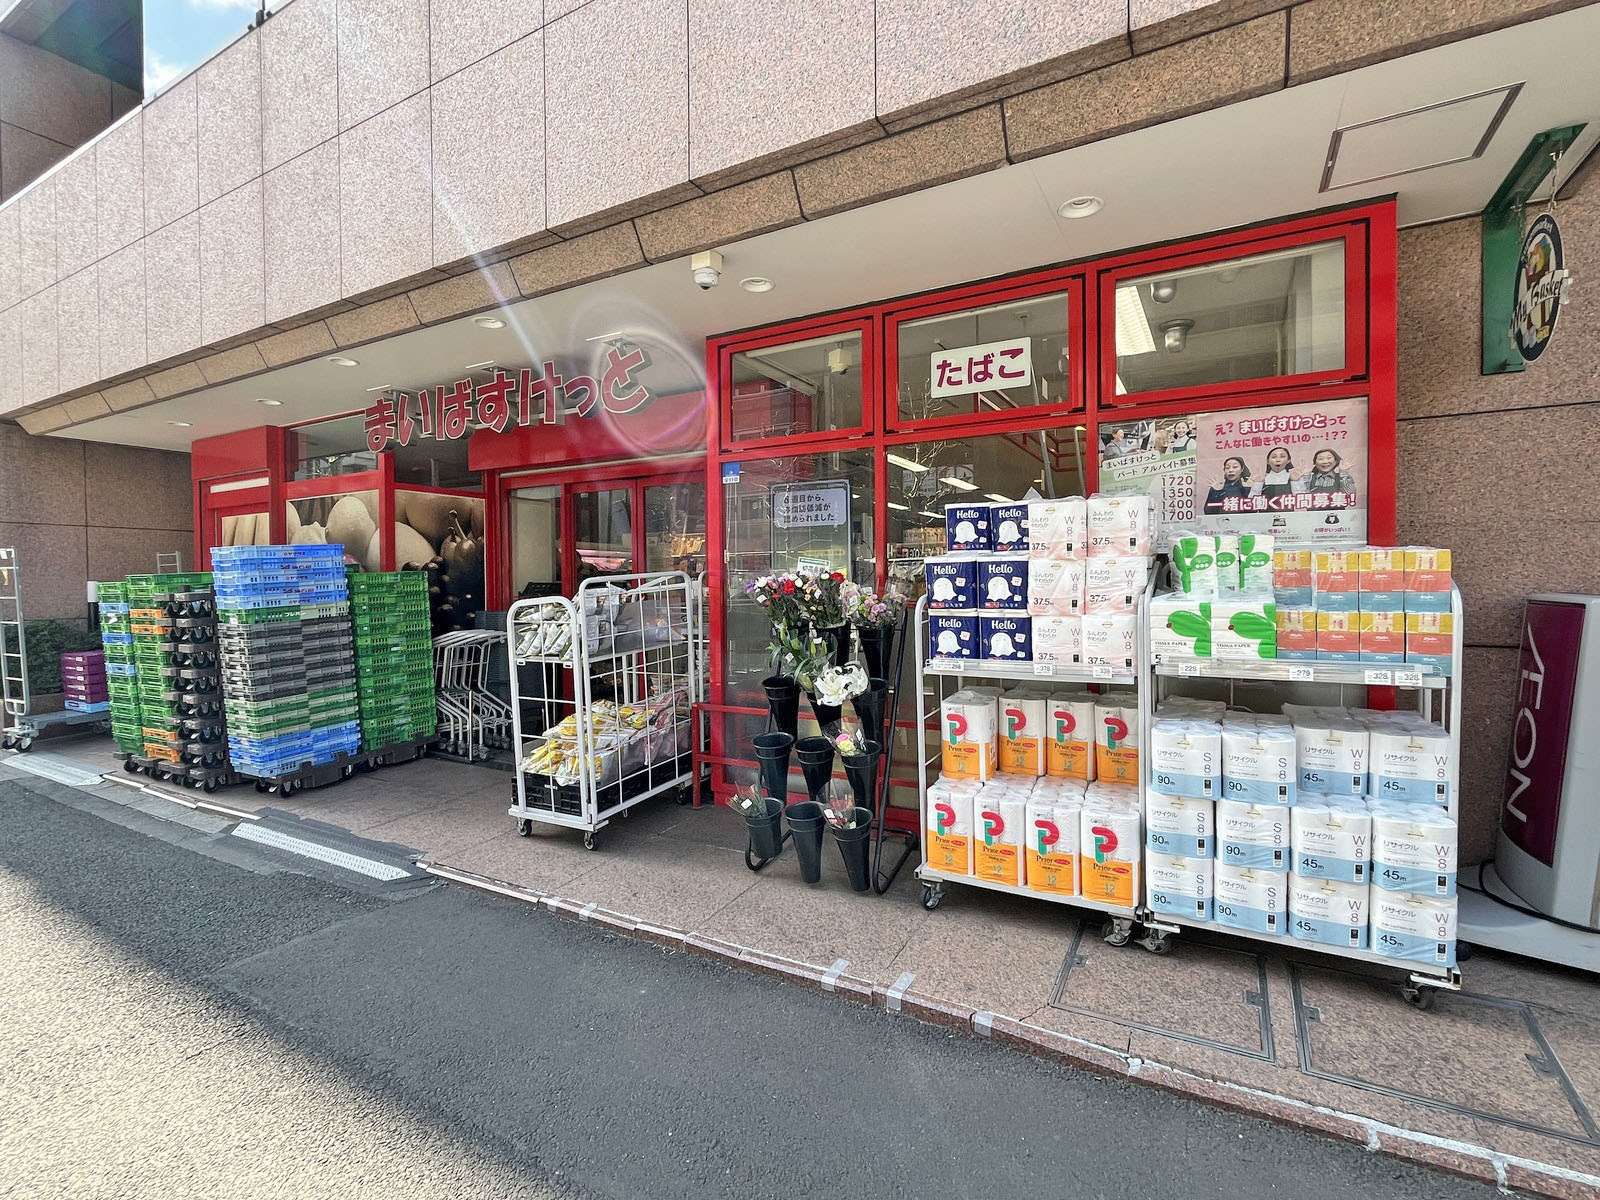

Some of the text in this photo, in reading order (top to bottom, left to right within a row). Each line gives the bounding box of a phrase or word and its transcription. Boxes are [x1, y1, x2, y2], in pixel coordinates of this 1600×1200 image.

[936, 347, 1025, 389] たばこ
[364, 347, 649, 452] まいばすけっと
[1106, 453, 1157, 469] まいばすけっと
[1162, 475, 1193, 486] 1720
[1162, 487, 1193, 498] 1350
[1162, 499, 1193, 509] 1400
[956, 510, 979, 519] Hello
[998, 508, 1022, 519] Hello
[1128, 510, 1139, 518] W
[1162, 510, 1193, 521] 1700
[1064, 515, 1075, 524] W
[1129, 520, 1137, 529] 8
[1066, 526, 1073, 535] 8
[933, 565, 957, 575] Hello
[989, 564, 1013, 574] Hello
[1125, 570, 1136, 578] W
[1070, 573, 1081, 581] W
[1127, 580, 1133, 588] 8
[938, 618, 962, 628] Hello
[991, 620, 1016, 630] Hello
[1070, 628, 1081, 636] W
[1121, 631, 1133, 639] W
[1072, 638, 1080, 646] 8
[1125, 641, 1132, 650] 8
[1203, 752, 1212, 762] S
[1350, 749, 1363, 759] W
[1278, 757, 1287, 768] S
[1434, 755, 1448, 765] W
[1203, 763, 1211, 773] 8
[1353, 761, 1361, 770] 8
[1279, 770, 1287, 780] 8
[1437, 768, 1445, 778] 8
[1196, 812, 1205, 822] S
[1197, 823, 1205, 833] 8
[1273, 822, 1282, 832] S
[1274, 834, 1281, 844] 8
[1352, 835, 1366, 845] W
[1355, 847, 1363, 858] 8
[1435, 845, 1449, 856] W
[1438, 858, 1447, 869] 8
[1196, 874, 1204, 884] S
[1196, 885, 1204, 895] 8
[1267, 887, 1276, 898] S
[1267, 899, 1276, 909] 8
[1348, 900, 1362, 911] W
[1350, 912, 1359, 923] 8
[1435, 913, 1449, 924] W
[1438, 926, 1446, 937] 8
